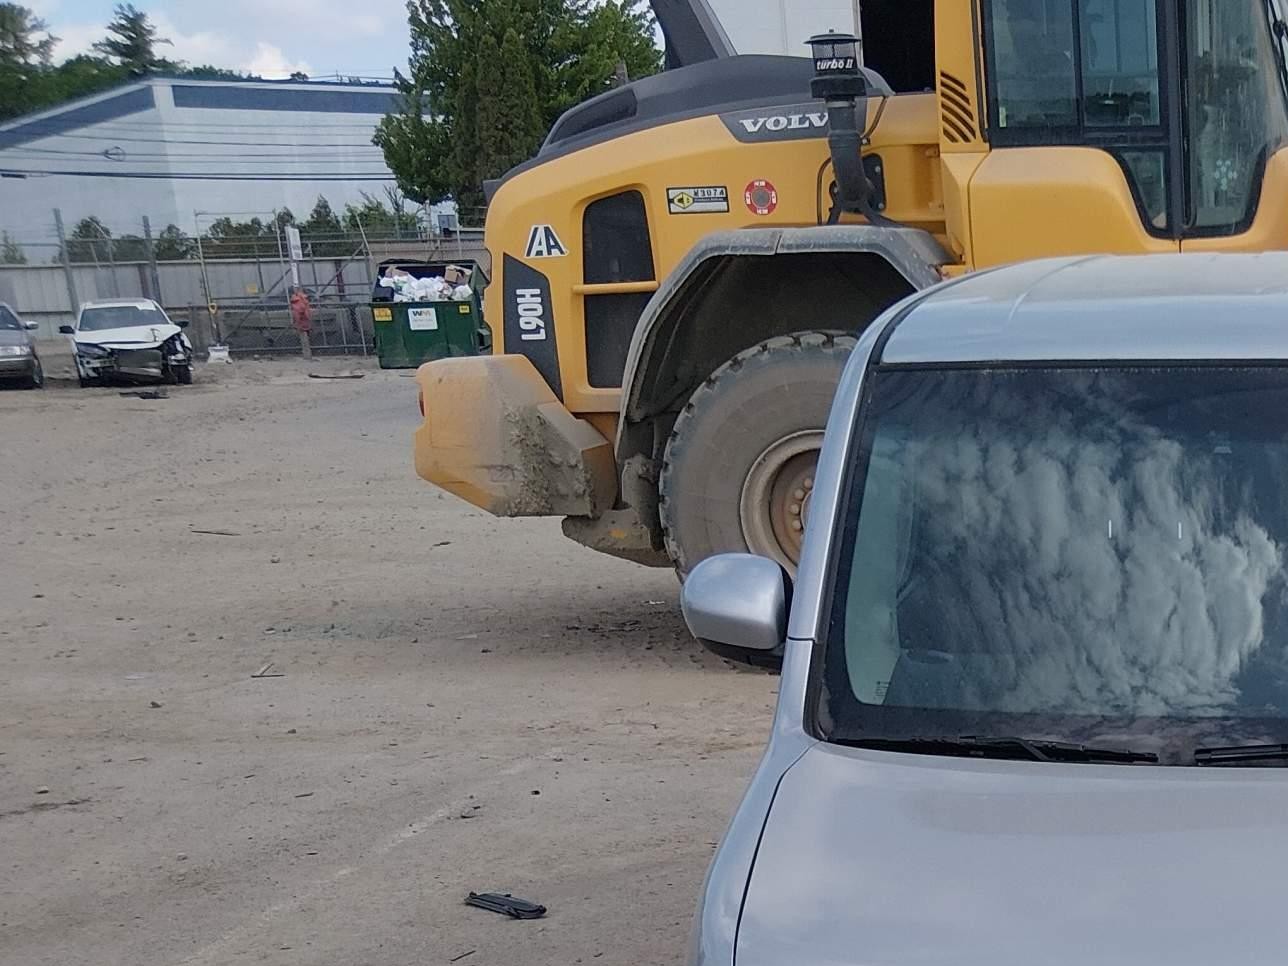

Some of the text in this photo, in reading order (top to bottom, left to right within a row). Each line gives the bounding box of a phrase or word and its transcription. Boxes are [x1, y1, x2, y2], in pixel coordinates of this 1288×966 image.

[816, 58, 844, 70] turbo
[739, 112, 829, 133] VOLV
[516, 288, 546, 341] L90H
